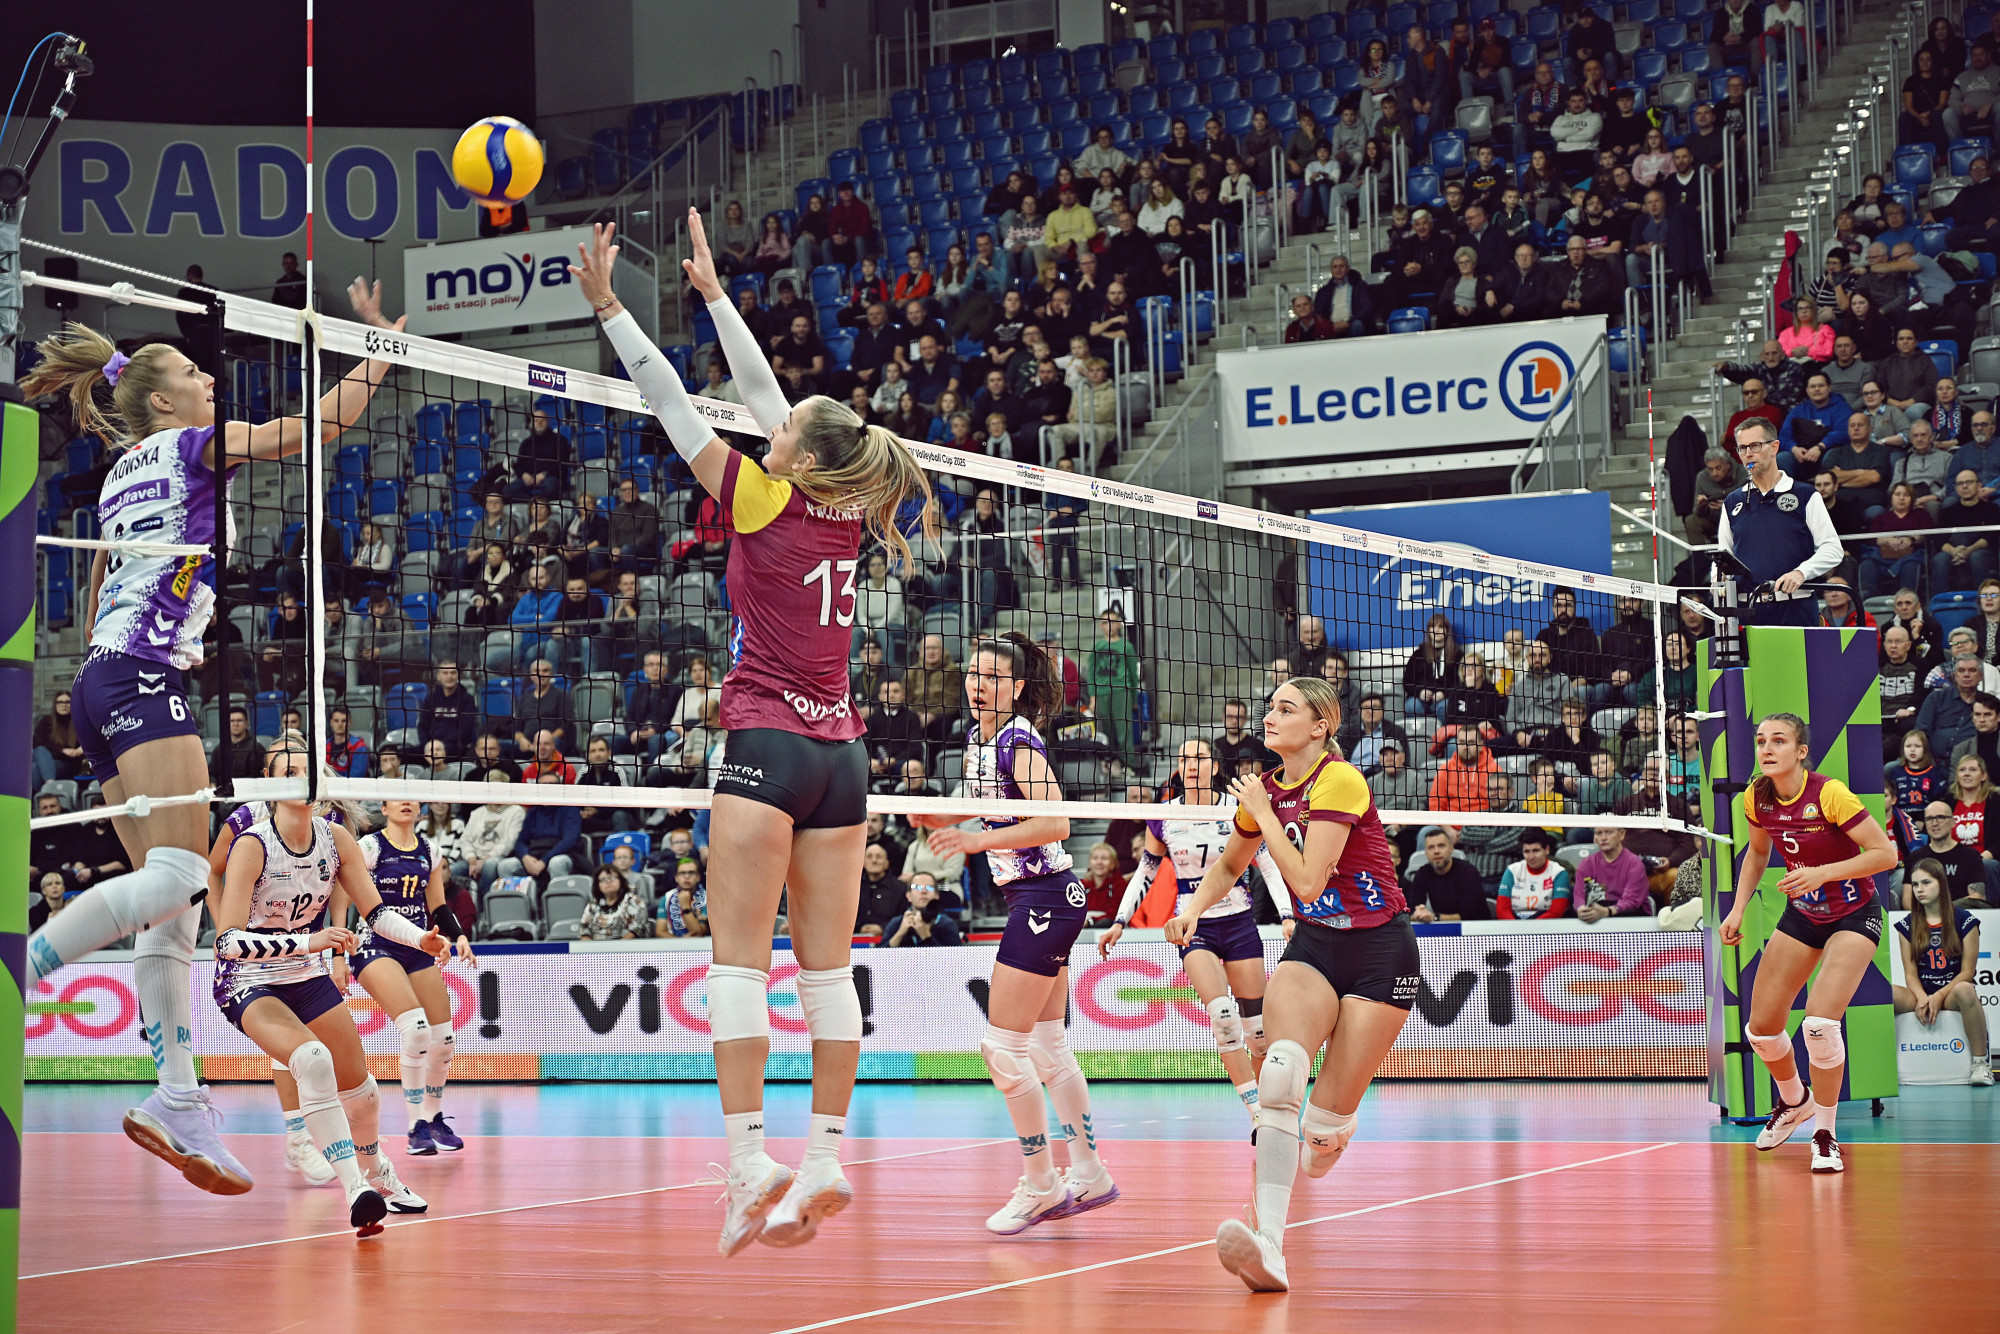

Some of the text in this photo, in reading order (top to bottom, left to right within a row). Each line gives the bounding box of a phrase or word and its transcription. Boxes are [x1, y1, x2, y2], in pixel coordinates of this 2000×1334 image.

[57, 138, 481, 241] RADOM
[426, 251, 572, 311] moya
[454, 297, 487, 310] stacji
[490, 293, 521, 307] paliw
[382, 338, 409, 356] CEV
[531, 368, 566, 389] moya
[705, 406, 719, 420] Cup
[720, 409, 736, 421] 2025
[1246, 376, 1489, 429] E.Leclerc
[915, 449, 942, 463] Volleyball
[941, 454, 953, 467] Cup
[953, 456, 967, 467] 2025
[1102, 486, 1112, 496] CEV
[1112, 489, 1134, 500] Volleyball
[1134, 492, 1144, 504] Cup
[802, 558, 858, 628] 13
[1397, 568, 1545, 611] Enea
[168, 695, 186, 722] 6
[1277, 800, 1297, 808] JAKO
[1782, 830, 1800, 854] 5
[1196, 843, 1209, 869] 7
[401, 874, 419, 898] 11
[289, 892, 313, 922] 12
[1927, 948, 1947, 970] 13
[1900, 1042, 1949, 1052] E.Leclerc
